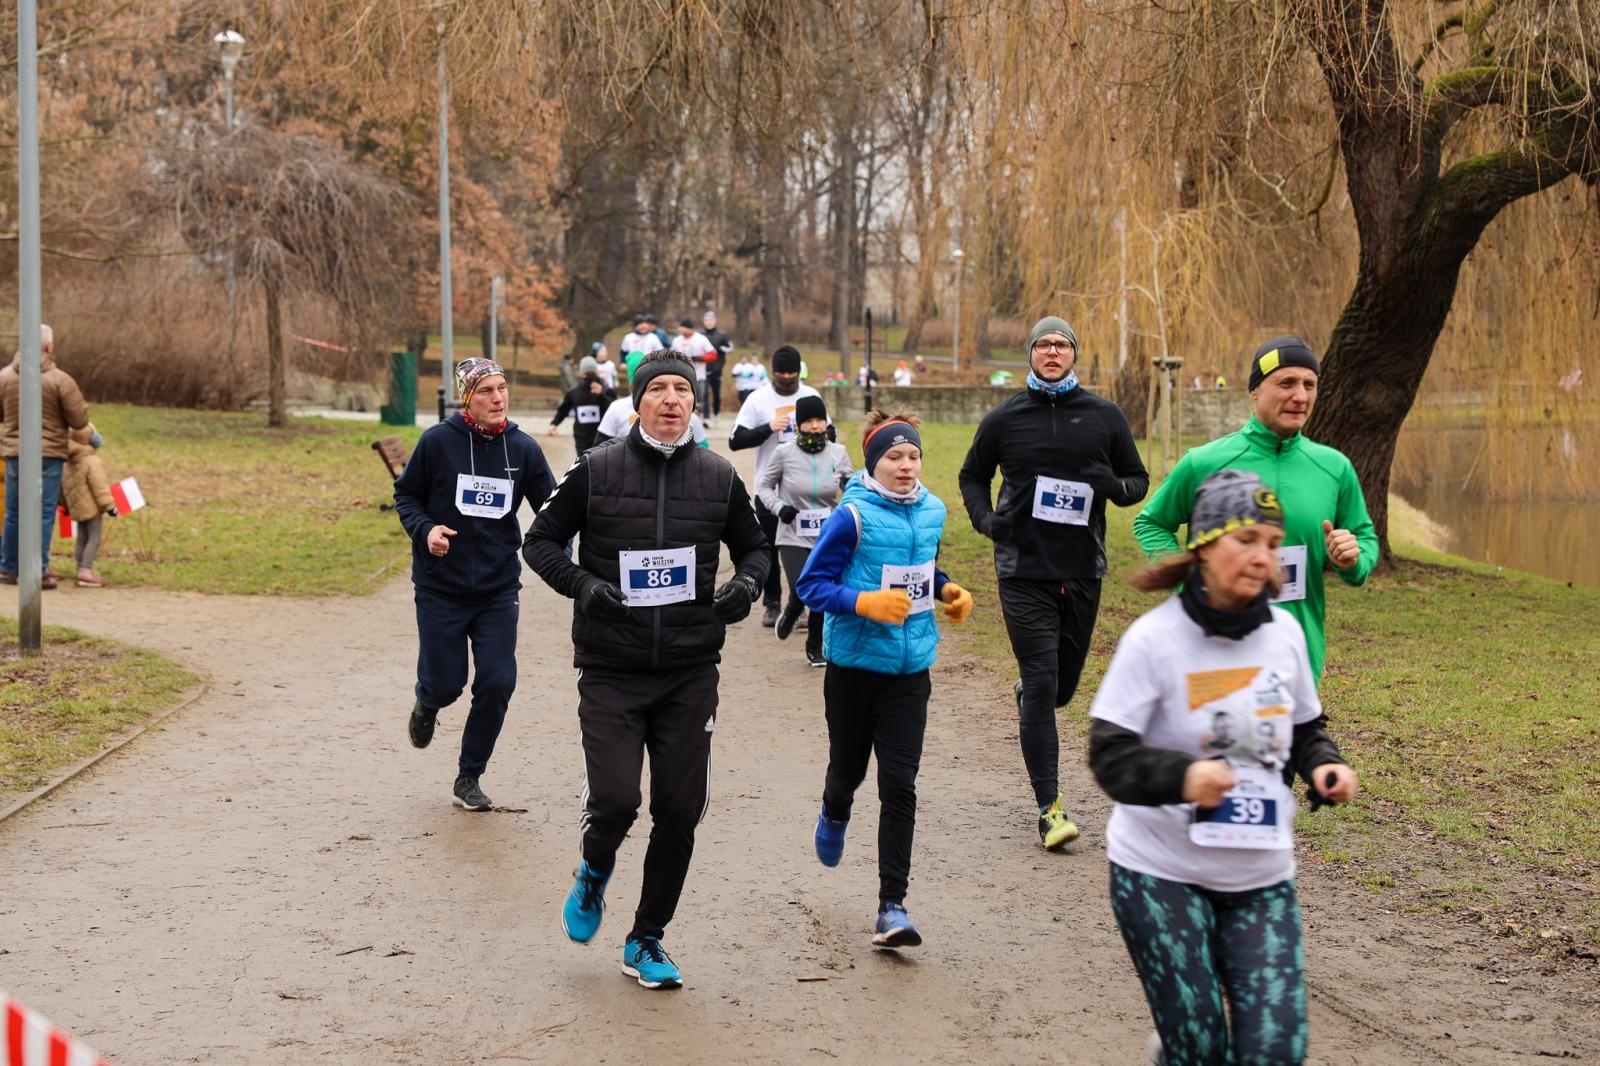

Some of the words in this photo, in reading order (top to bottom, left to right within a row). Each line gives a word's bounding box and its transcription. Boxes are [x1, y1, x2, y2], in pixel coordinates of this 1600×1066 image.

[475, 492, 494, 505] 69
[1054, 495, 1074, 510] 52
[647, 569, 672, 587] 86
[906, 583, 923, 599] 85
[1230, 797, 1265, 824] 39
